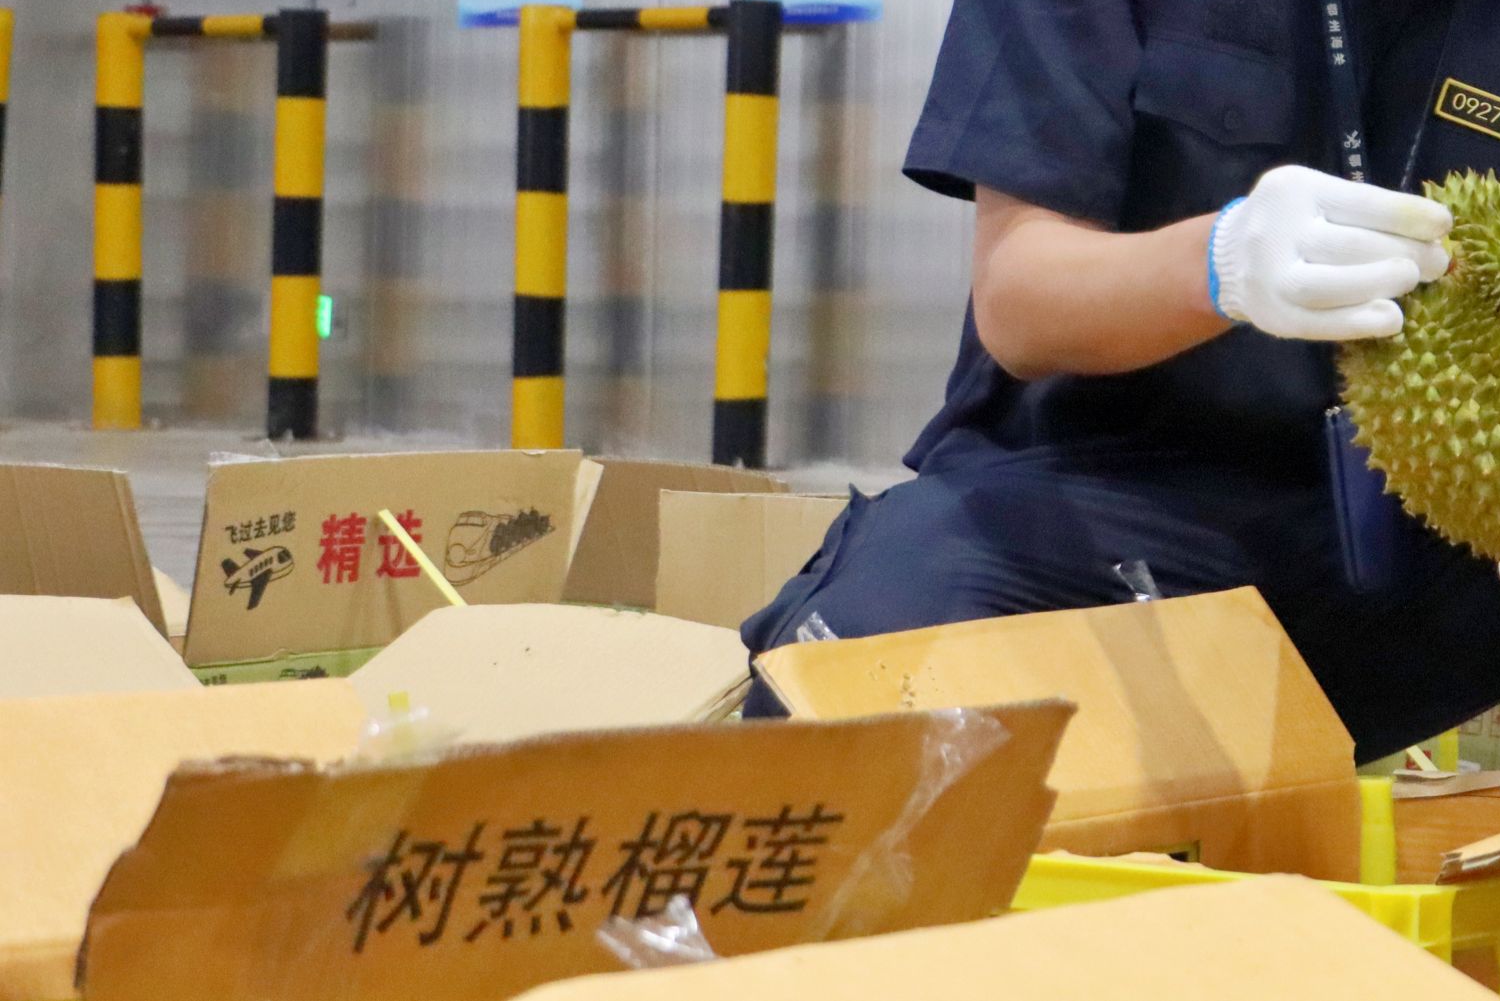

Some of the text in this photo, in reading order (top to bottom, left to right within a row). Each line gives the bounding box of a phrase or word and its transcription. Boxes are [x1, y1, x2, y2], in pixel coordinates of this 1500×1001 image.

[225, 510, 296, 544] 飞过去见您
[316, 509, 422, 584] 精选
[345, 803, 844, 954] 树熟榴莲
